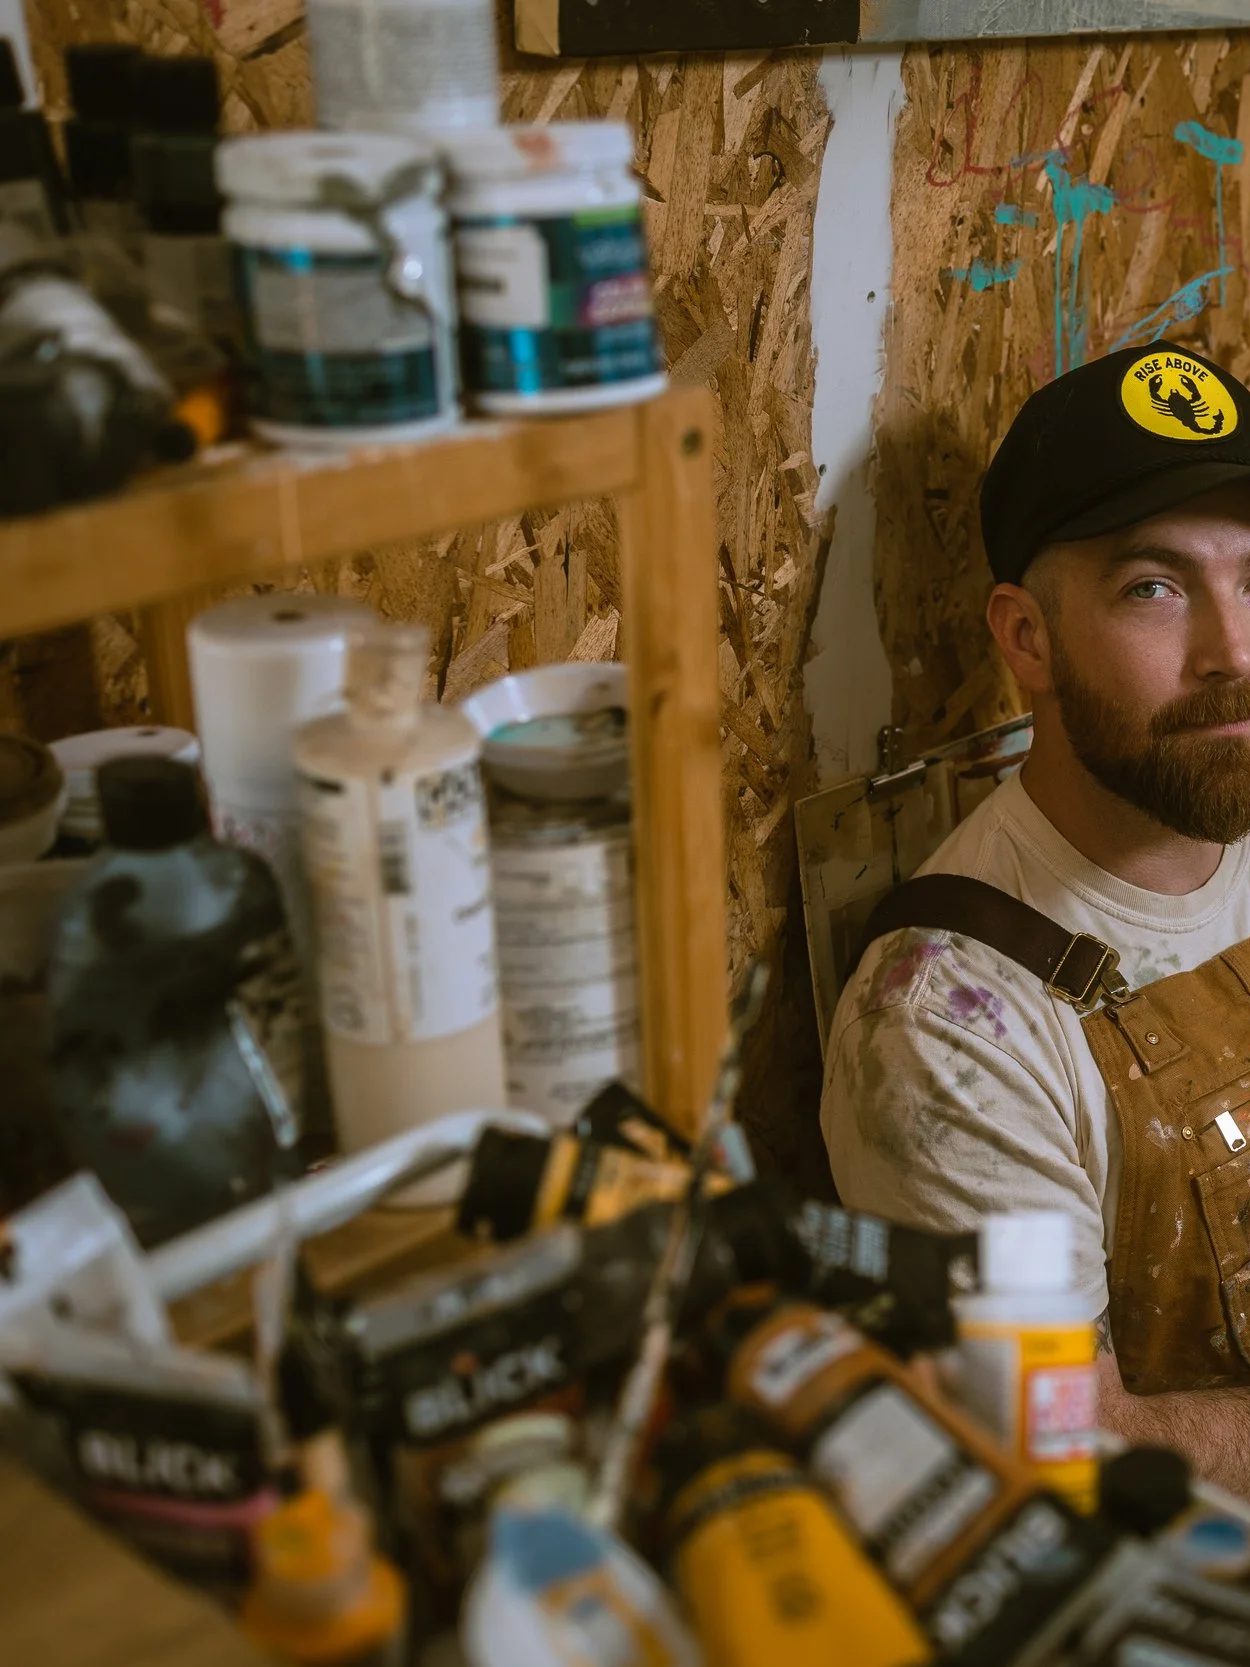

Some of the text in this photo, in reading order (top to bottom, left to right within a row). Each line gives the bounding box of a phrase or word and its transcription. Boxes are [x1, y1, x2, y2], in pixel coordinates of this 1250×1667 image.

[1134, 357, 1208, 382] RISE ABOVE
[79, 1430, 236, 1492] BLICK
